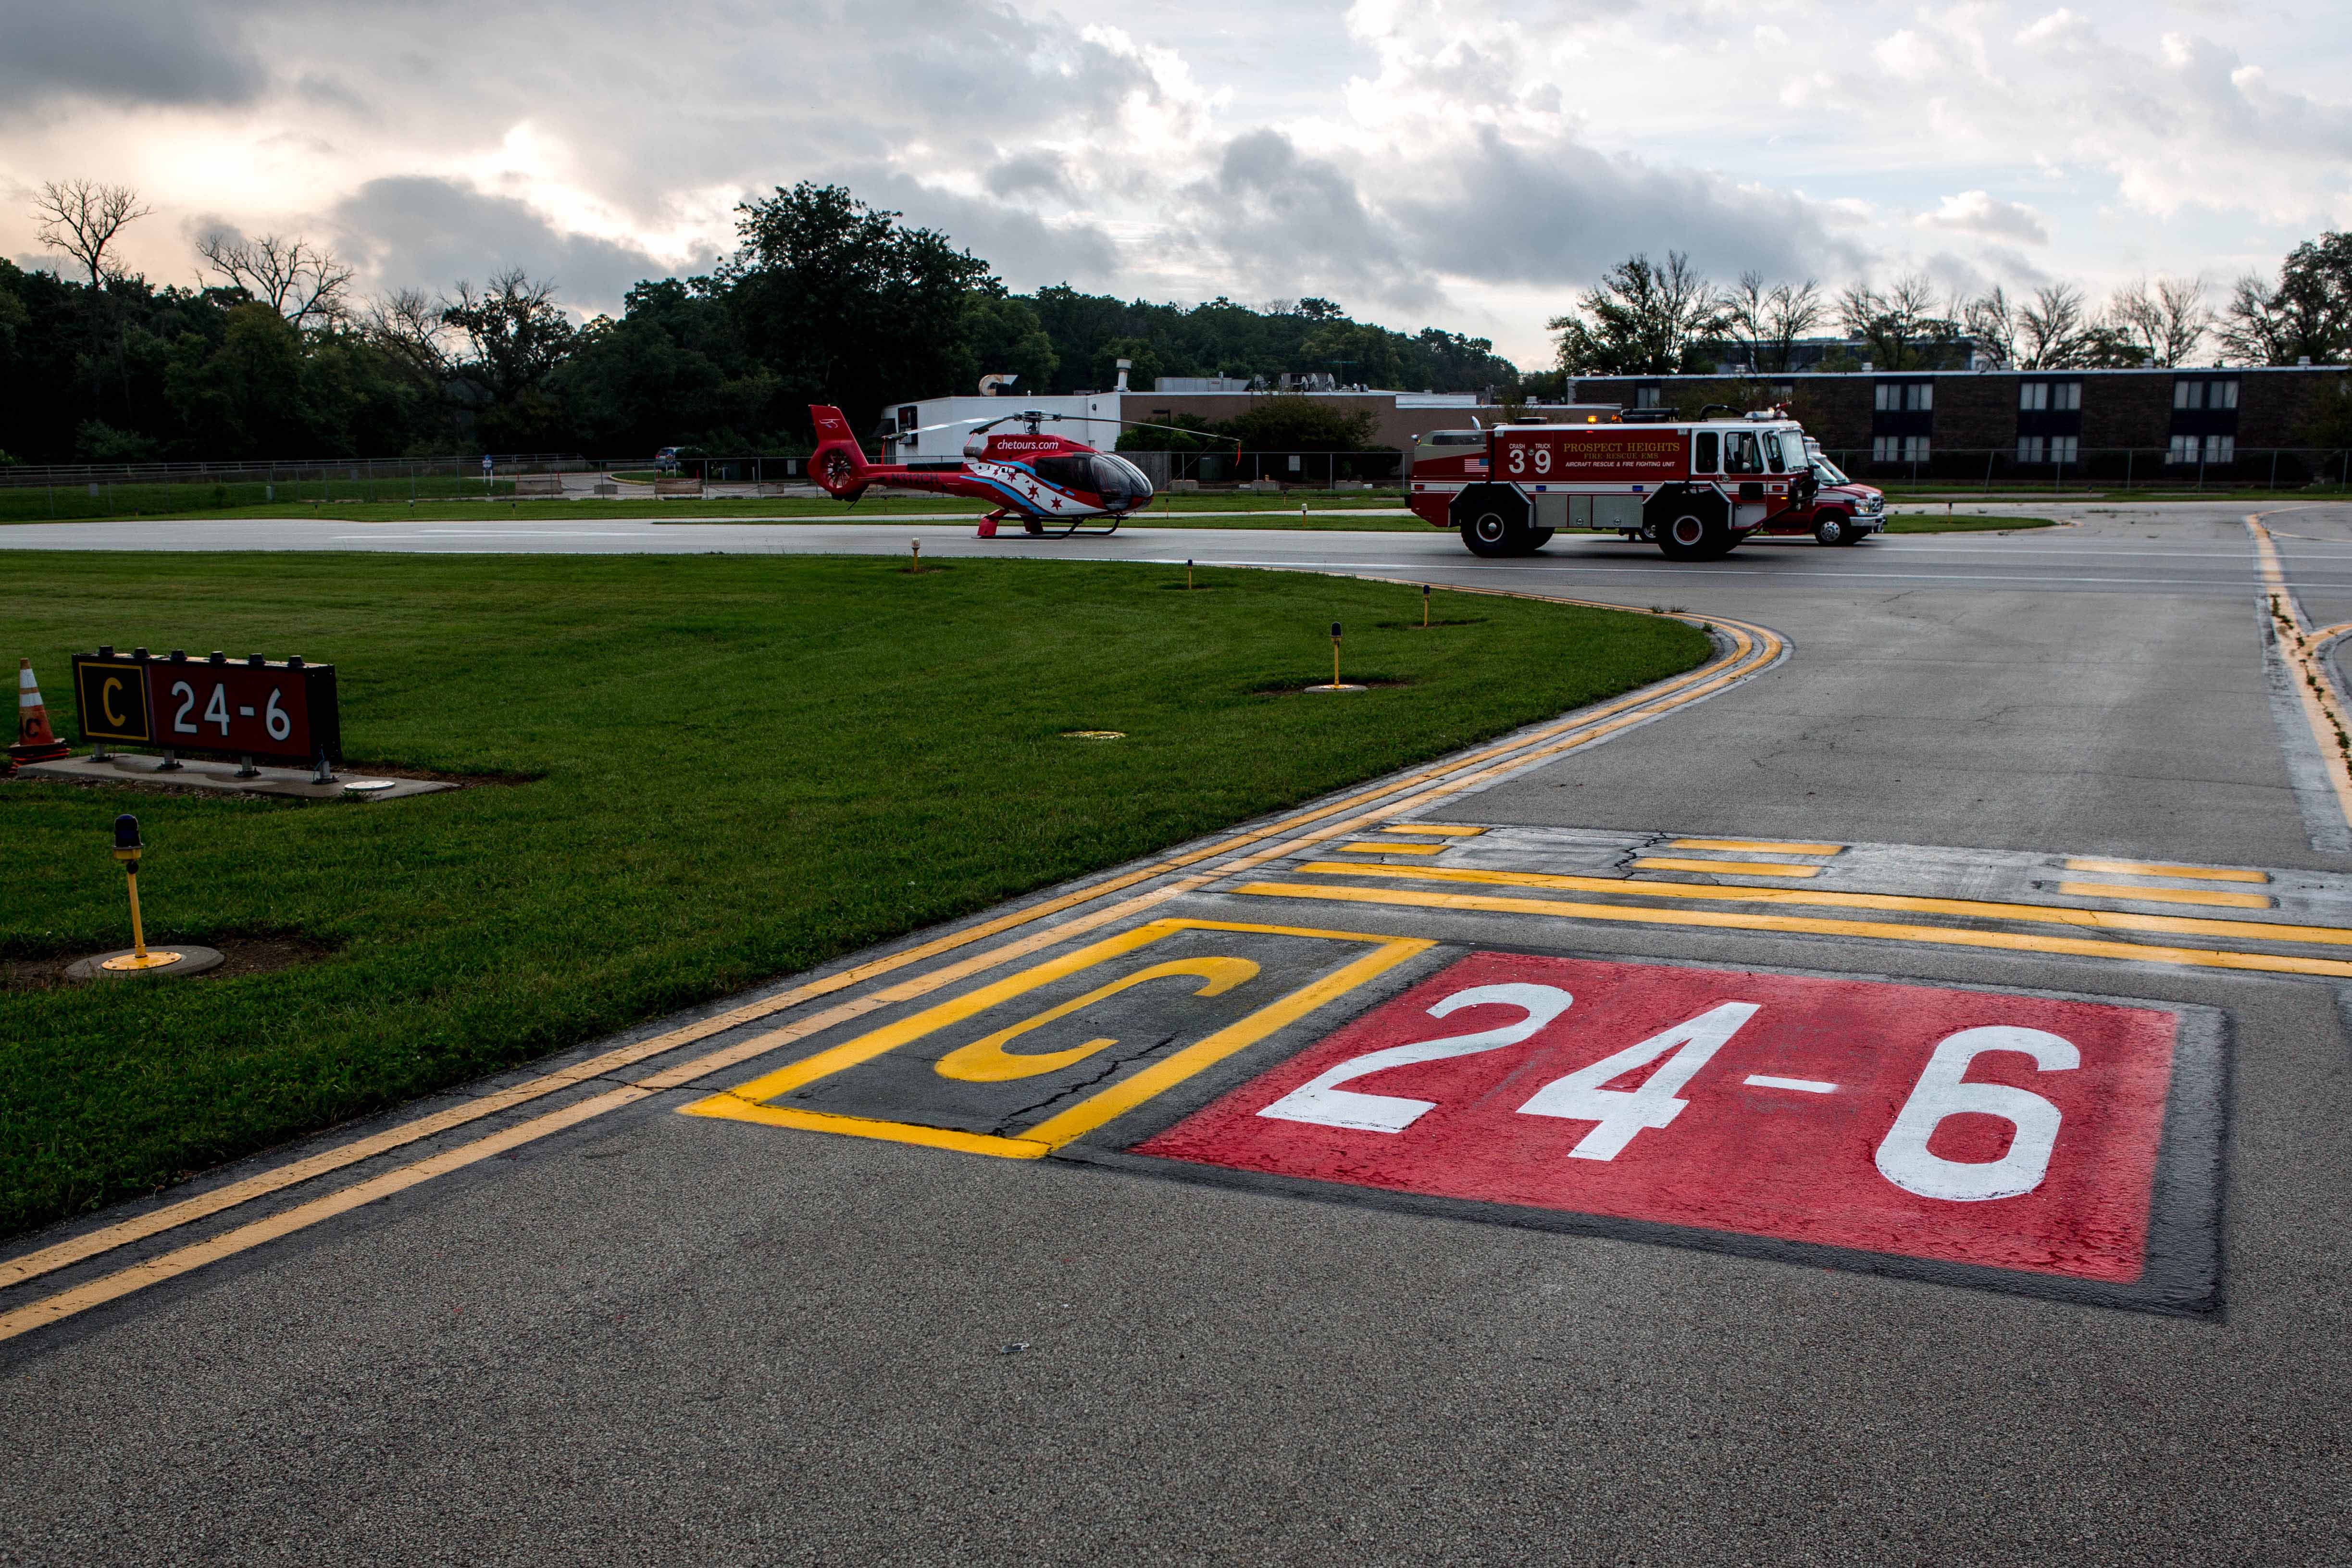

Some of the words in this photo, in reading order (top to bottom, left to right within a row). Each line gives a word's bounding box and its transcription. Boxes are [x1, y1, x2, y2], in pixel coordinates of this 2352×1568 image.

[997, 439, 1058, 449] chetours.com
[1564, 443, 1623, 452] PROSPECT
[1627, 442, 1680, 451] HEIGHTS
[1508, 449, 1525, 473] 3
[1535, 449, 1551, 474] 9
[102, 677, 126, 727] C
[171, 681, 291, 741] 24-6
[934, 956, 1261, 1083] C
[1256, 983, 2080, 1201] 24-6
